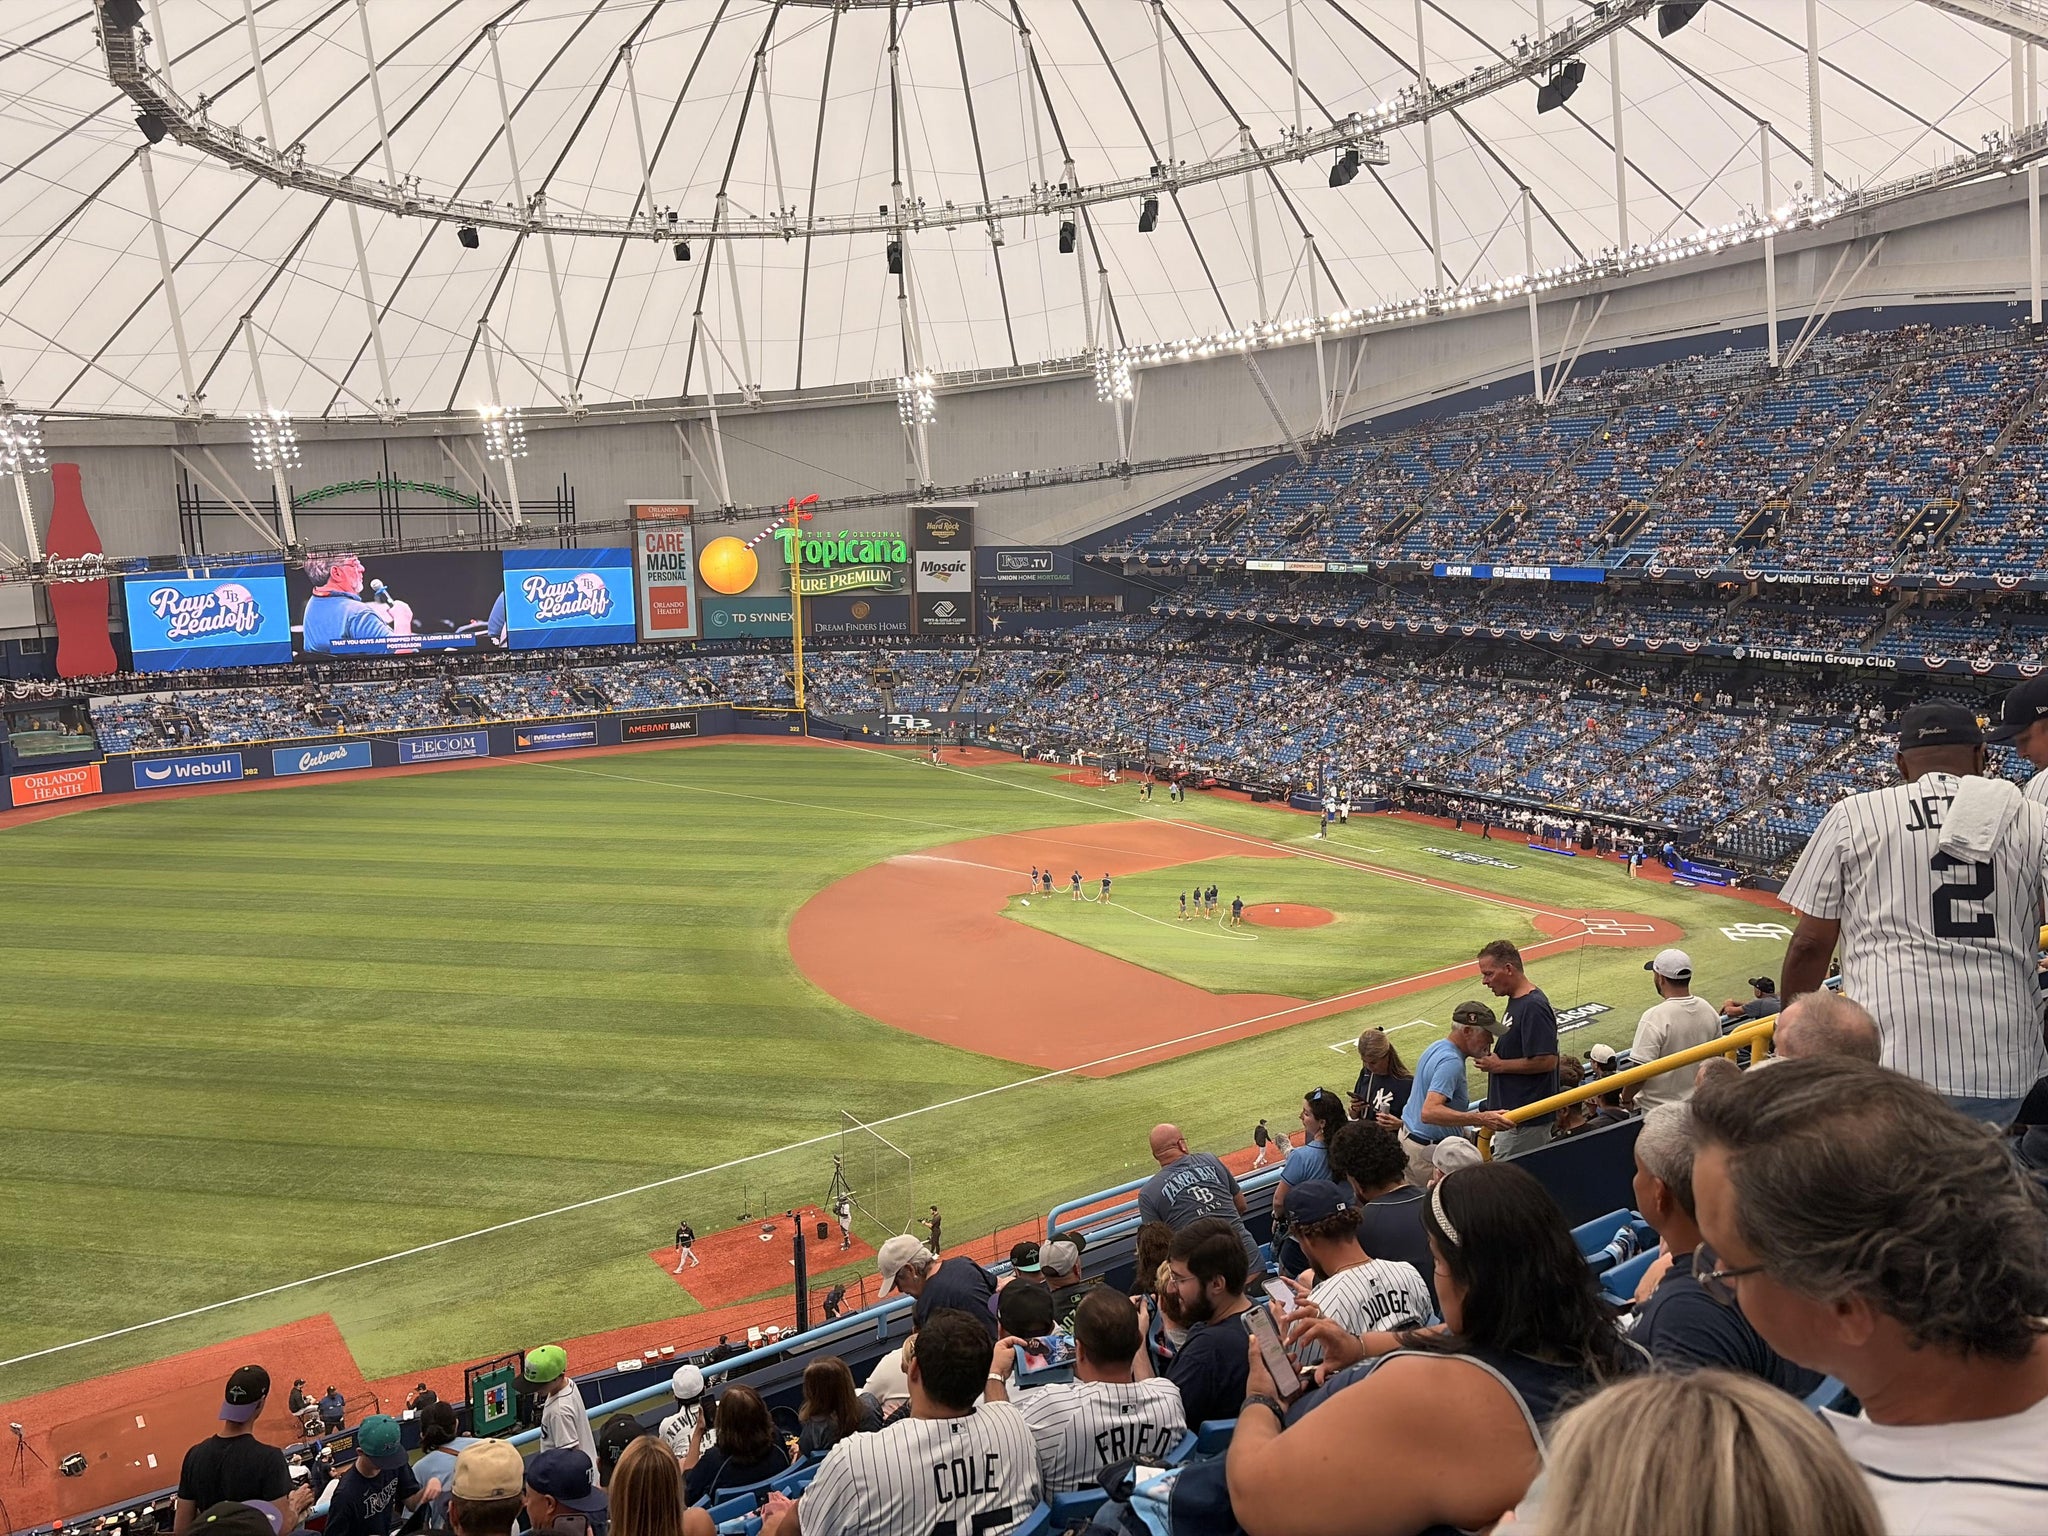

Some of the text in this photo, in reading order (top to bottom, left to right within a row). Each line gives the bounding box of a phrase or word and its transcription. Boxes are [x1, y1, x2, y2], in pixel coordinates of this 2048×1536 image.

[296, 479, 480, 508] TROPICANA FIELD
[926, 522, 960, 531] Hard Rock
[646, 533, 685, 553] CARE
[774, 527, 907, 568] Tropicana
[647, 553, 686, 571] MADE
[920, 560, 966, 572] Mosaic
[647, 571, 687, 582] PERSONAL
[829, 569, 891, 590] PREMIUM
[1779, 573, 1869, 587] Webull Suite Level
[523, 575, 575, 601] Rays
[150, 586, 215, 620] Rays
[535, 590, 611, 620] Leadoff
[653, 601, 685, 609] ORLANDO
[657, 607, 682, 615] HEALTH
[168, 602, 259, 639] Leadoff
[731, 613, 795, 623] TD SYNNEX
[815, 622, 907, 633] DREAM FINDERS HOMES
[1748, 648, 1896, 668] The Baldwin Group Club
[533, 731, 594, 742] MicroLumen
[628, 720, 691, 735] AMERANT BANK
[411, 737, 477, 754] LECOM
[299, 746, 348, 771] Culver's
[174, 759, 232, 778] Webull
[244, 768, 258, 776] 382
[24, 769, 87, 789] ORLANDO
[33, 782, 83, 800] HEALTH
[1930, 851, 1996, 938] 2
[1161, 1169, 1200, 1206] TAMPA
[1195, 1165, 1221, 1184] BAY
[1187, 1185, 1214, 1204] TB
[1196, 1200, 1222, 1216] RAYS
[1362, 1289, 1411, 1329] JUDGE
[1095, 1423, 1172, 1466] FRIED
[933, 1453, 1000, 1504] COLE
